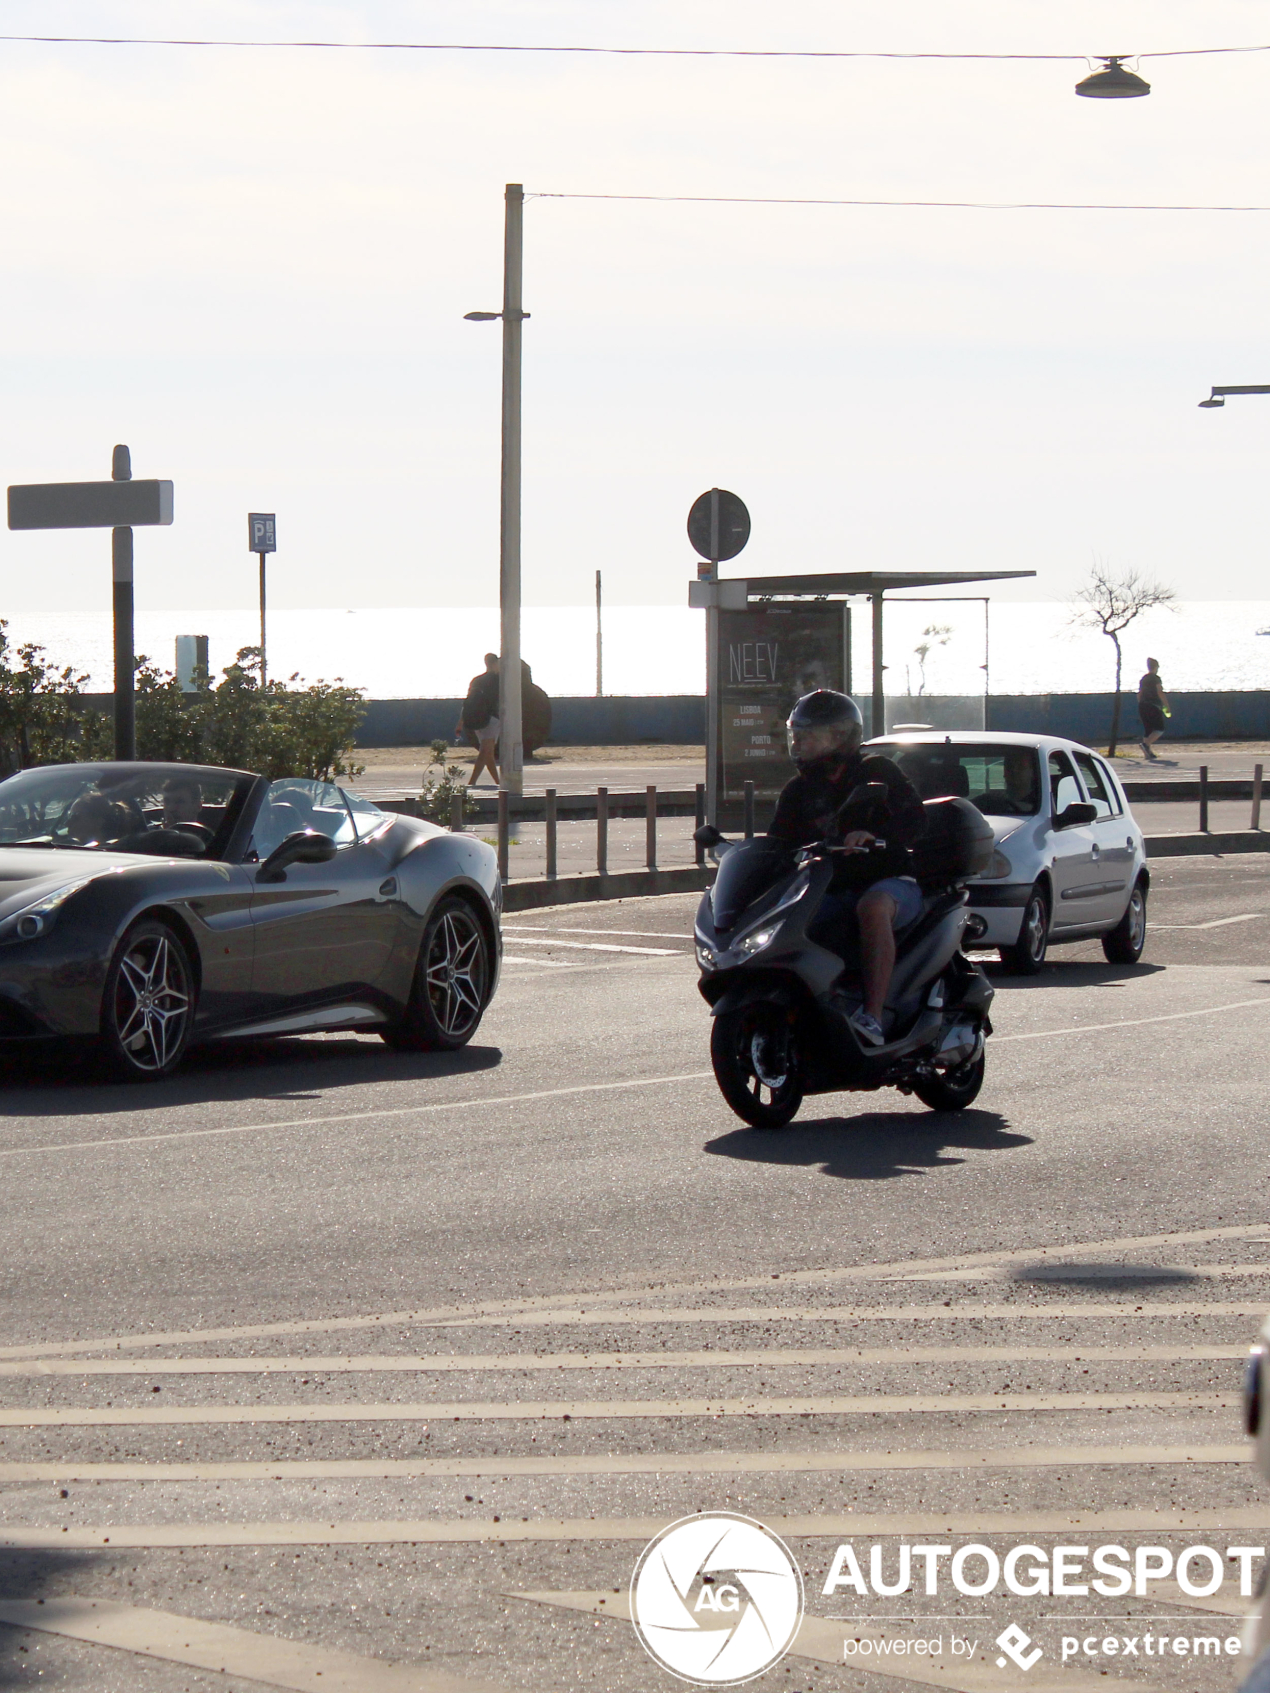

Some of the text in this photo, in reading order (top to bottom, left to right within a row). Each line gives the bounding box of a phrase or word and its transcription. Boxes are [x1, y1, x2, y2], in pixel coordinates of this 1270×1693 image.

[730, 643, 778, 682] NEEV
[740, 705, 761, 714] LISBOA
[751, 735, 771, 745] PORTO
